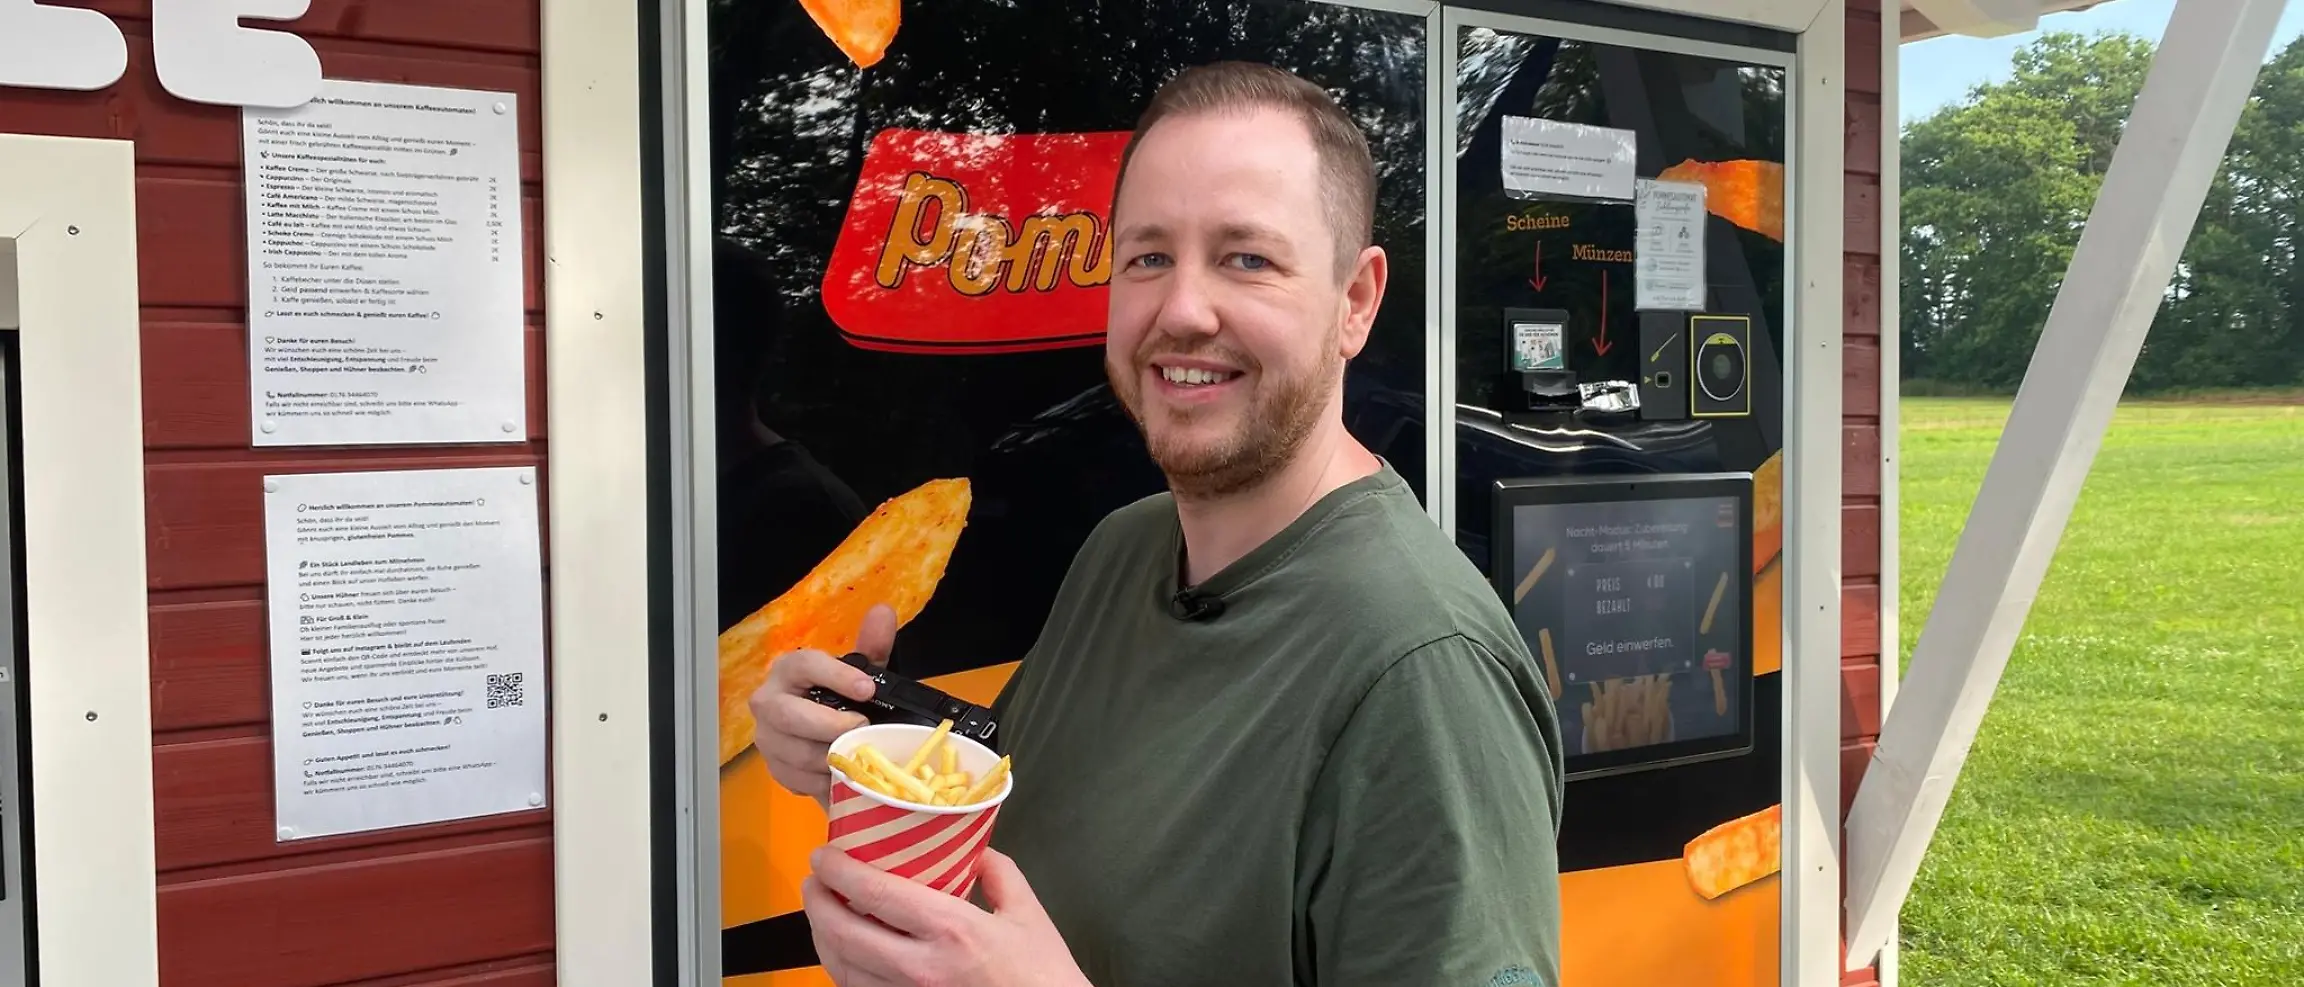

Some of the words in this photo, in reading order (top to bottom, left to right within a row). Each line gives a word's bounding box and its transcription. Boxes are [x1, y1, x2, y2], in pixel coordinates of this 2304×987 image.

[1506, 212, 1570, 231] Scheine
[1572, 243, 1633, 263] Münzen
[1591, 541, 1622, 553] dauert
[1596, 576, 1621, 592] PREIS
[1596, 598, 1630, 614] BEZAHLT
[1585, 640, 1613, 656] Geld
[1616, 636, 1675, 653] einwerfen.
[874, 699, 895, 710] ONY
